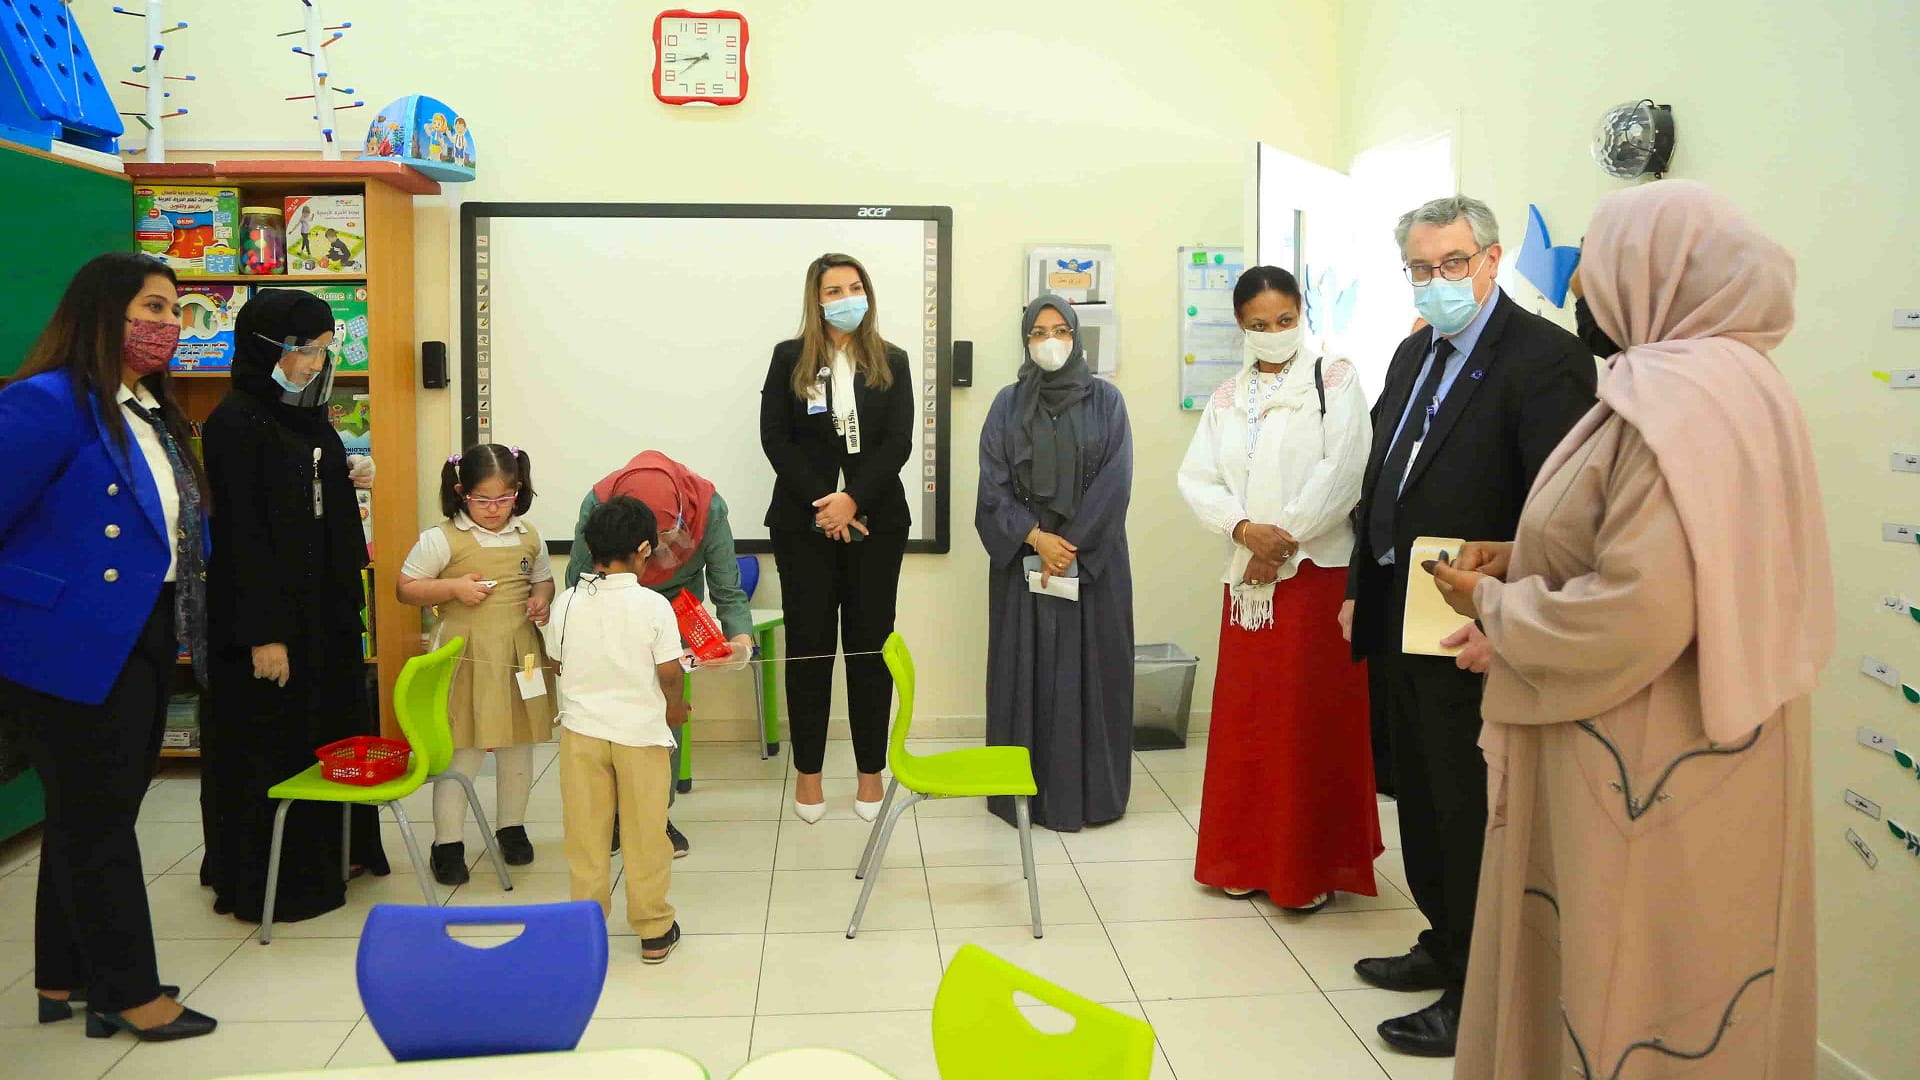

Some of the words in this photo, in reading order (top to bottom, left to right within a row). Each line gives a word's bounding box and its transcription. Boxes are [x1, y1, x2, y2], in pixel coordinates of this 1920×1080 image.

[680, 23, 688, 33] 11
[694, 22, 708, 35] 12
[664, 35, 678, 47] 10
[725, 36, 737, 48] 2
[664, 53, 676, 63] 9
[725, 54, 737, 65] 3
[665, 70, 676, 82] 8
[725, 71, 737, 82] 4
[679, 83, 688, 93] 7
[695, 83, 706, 94] 6
[712, 84, 724, 94] 5
[857, 207, 892, 217] acer
